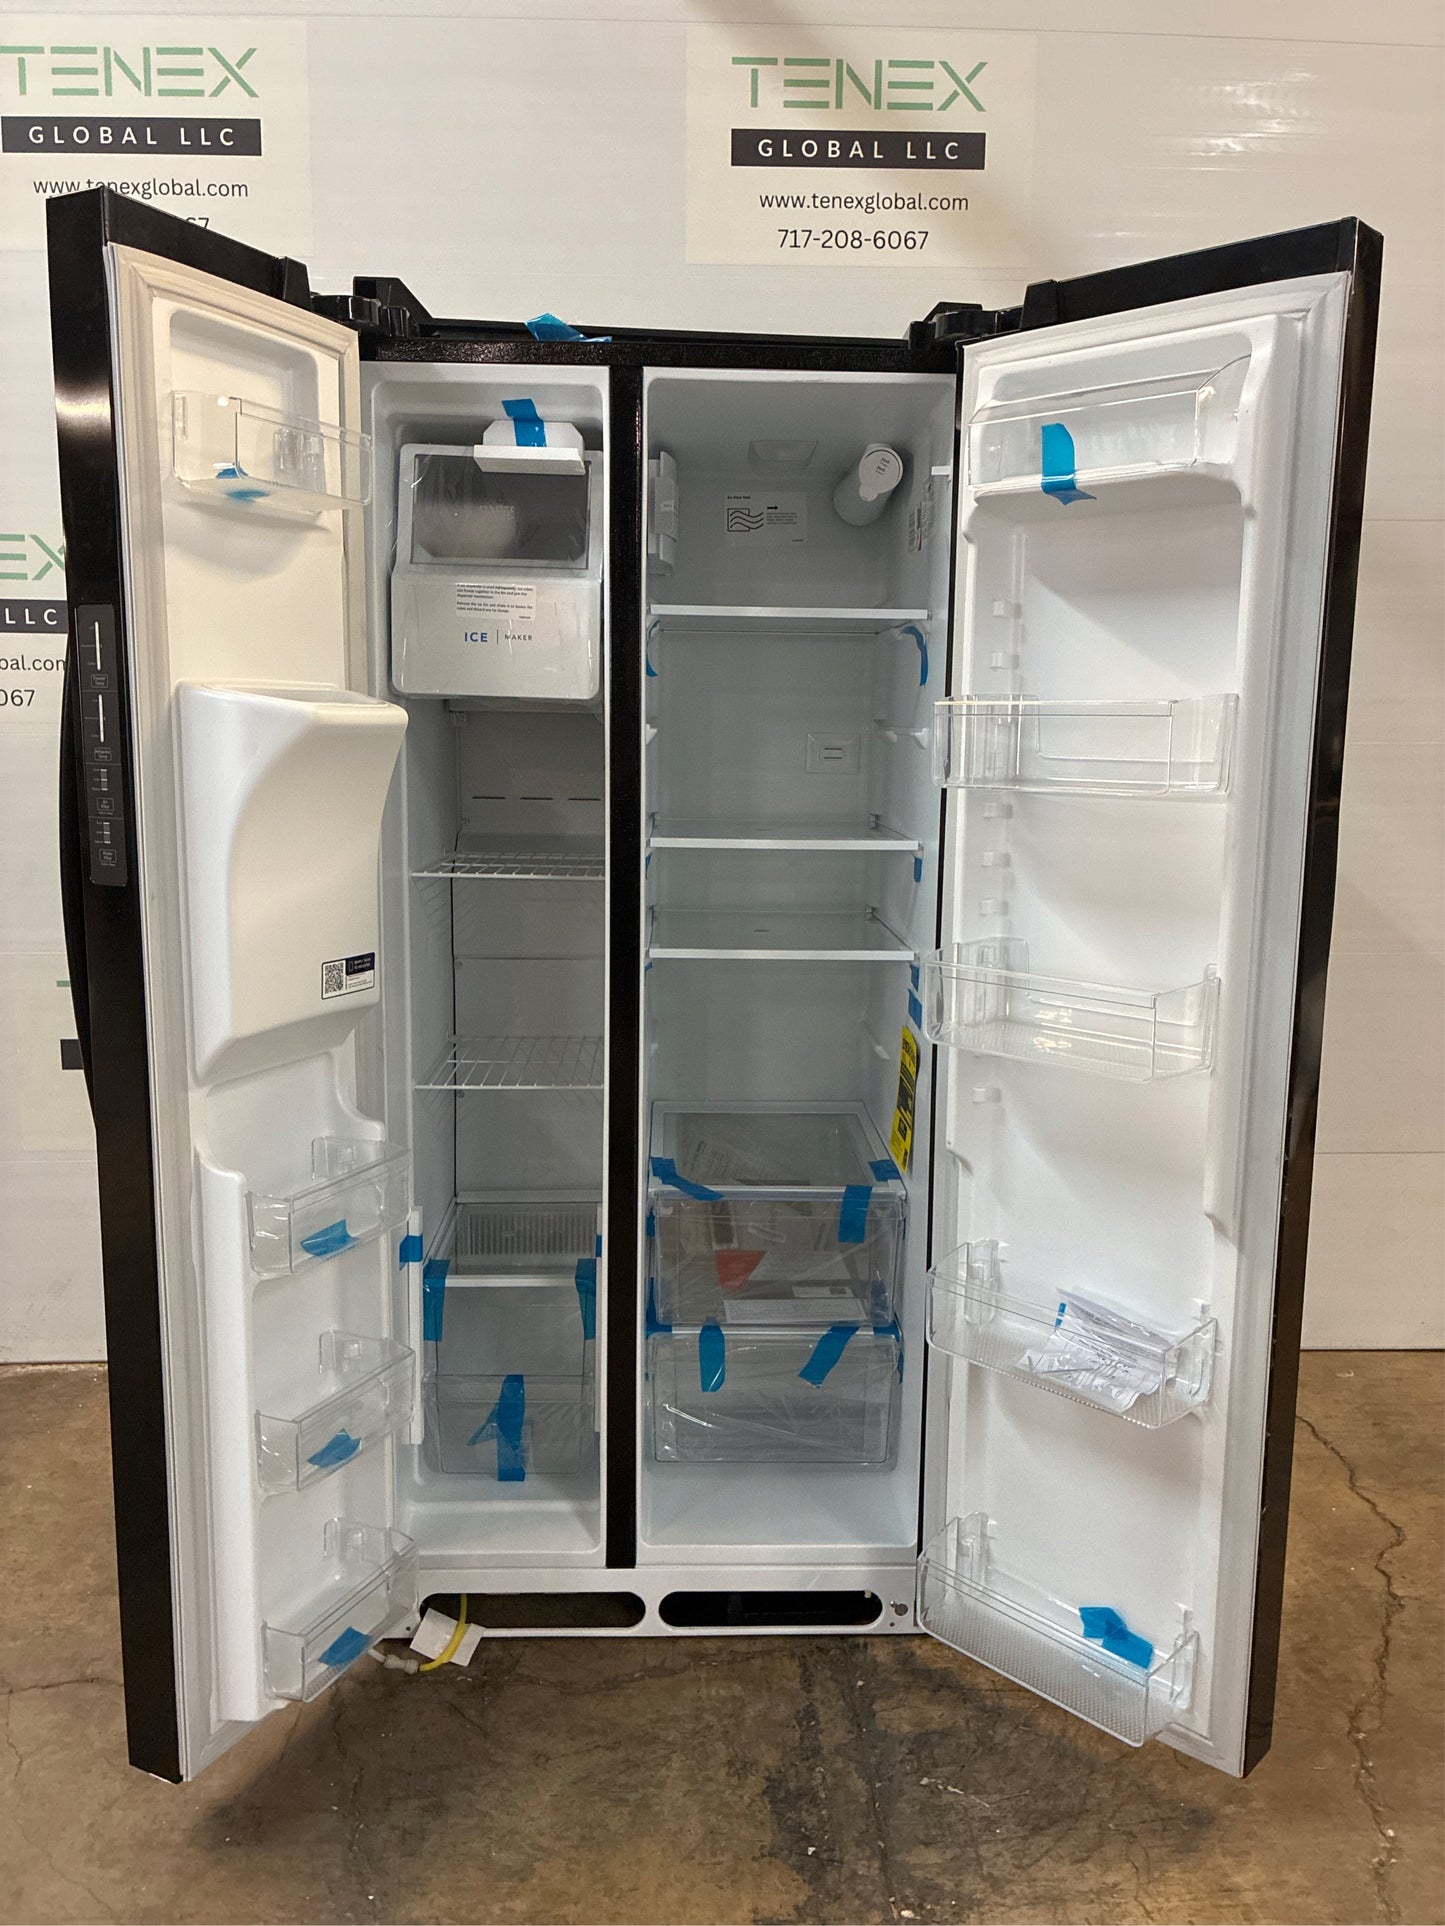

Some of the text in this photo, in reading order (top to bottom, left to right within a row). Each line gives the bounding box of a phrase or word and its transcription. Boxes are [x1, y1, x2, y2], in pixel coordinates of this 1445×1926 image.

[0, 46, 260, 98] TENEX
[731, 56, 988, 112] TENEX
[28, 126, 235, 146] GLOBAL LLC
[757, 139, 959, 160] GLOBAL LLC
[33, 178, 249, 200] wwwtnexglobal.com
[759, 192, 969, 214] www.tenexglobal.com
[777, 229, 929, 250] 717-208-6067
[5, 608, 58, 625] LLC
[464, 632, 488, 642] ICE
